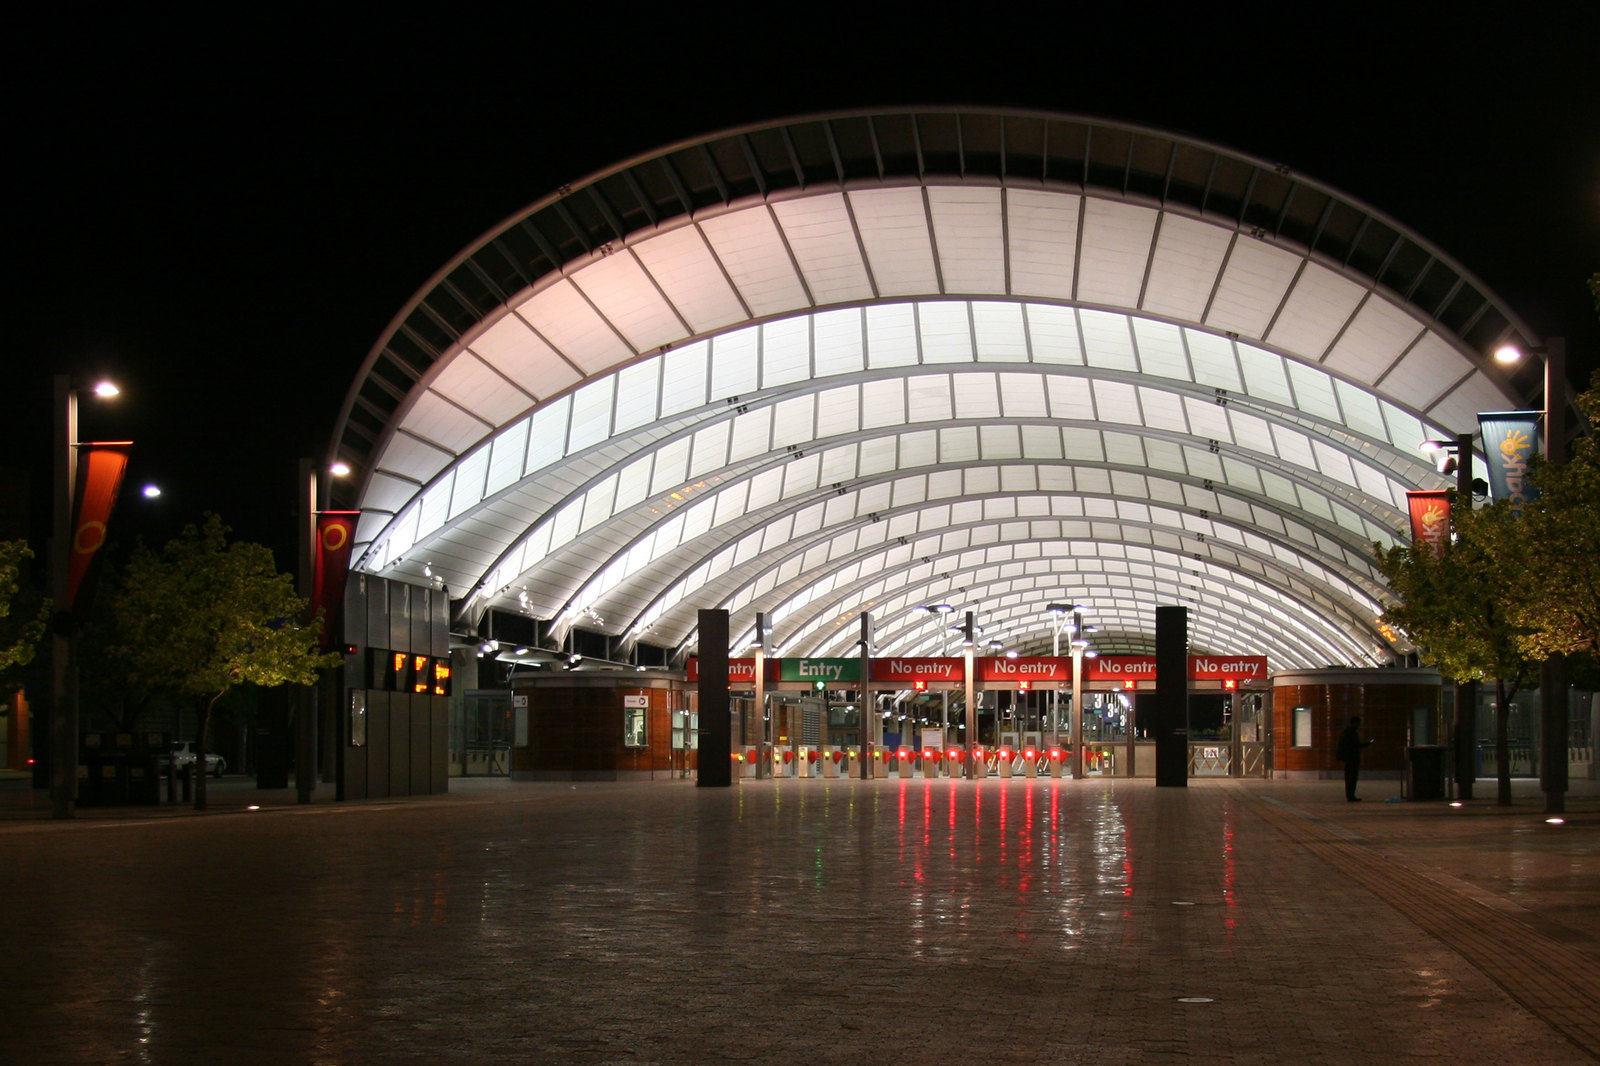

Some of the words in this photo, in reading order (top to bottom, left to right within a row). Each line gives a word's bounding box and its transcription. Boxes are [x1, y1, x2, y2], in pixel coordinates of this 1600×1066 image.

[404, 584, 410, 618] 2
[425, 588, 430, 622] 3
[729, 663, 755, 678] ntry
[799, 660, 842, 680] Entry
[891, 661, 912, 674] No
[915, 662, 952, 677] entry
[995, 660, 1016, 673] No
[1020, 662, 1056, 677] entry
[1100, 660, 1121, 673] No
[1124, 661, 1156, 673] entr
[1196, 659, 1218, 673] No
[1221, 661, 1259, 676] entry
[977, 692, 984, 709] 2
[1095, 693, 1102, 708] 3
[1107, 703, 1114, 717] 3
[1120, 715, 1125, 726] 3
